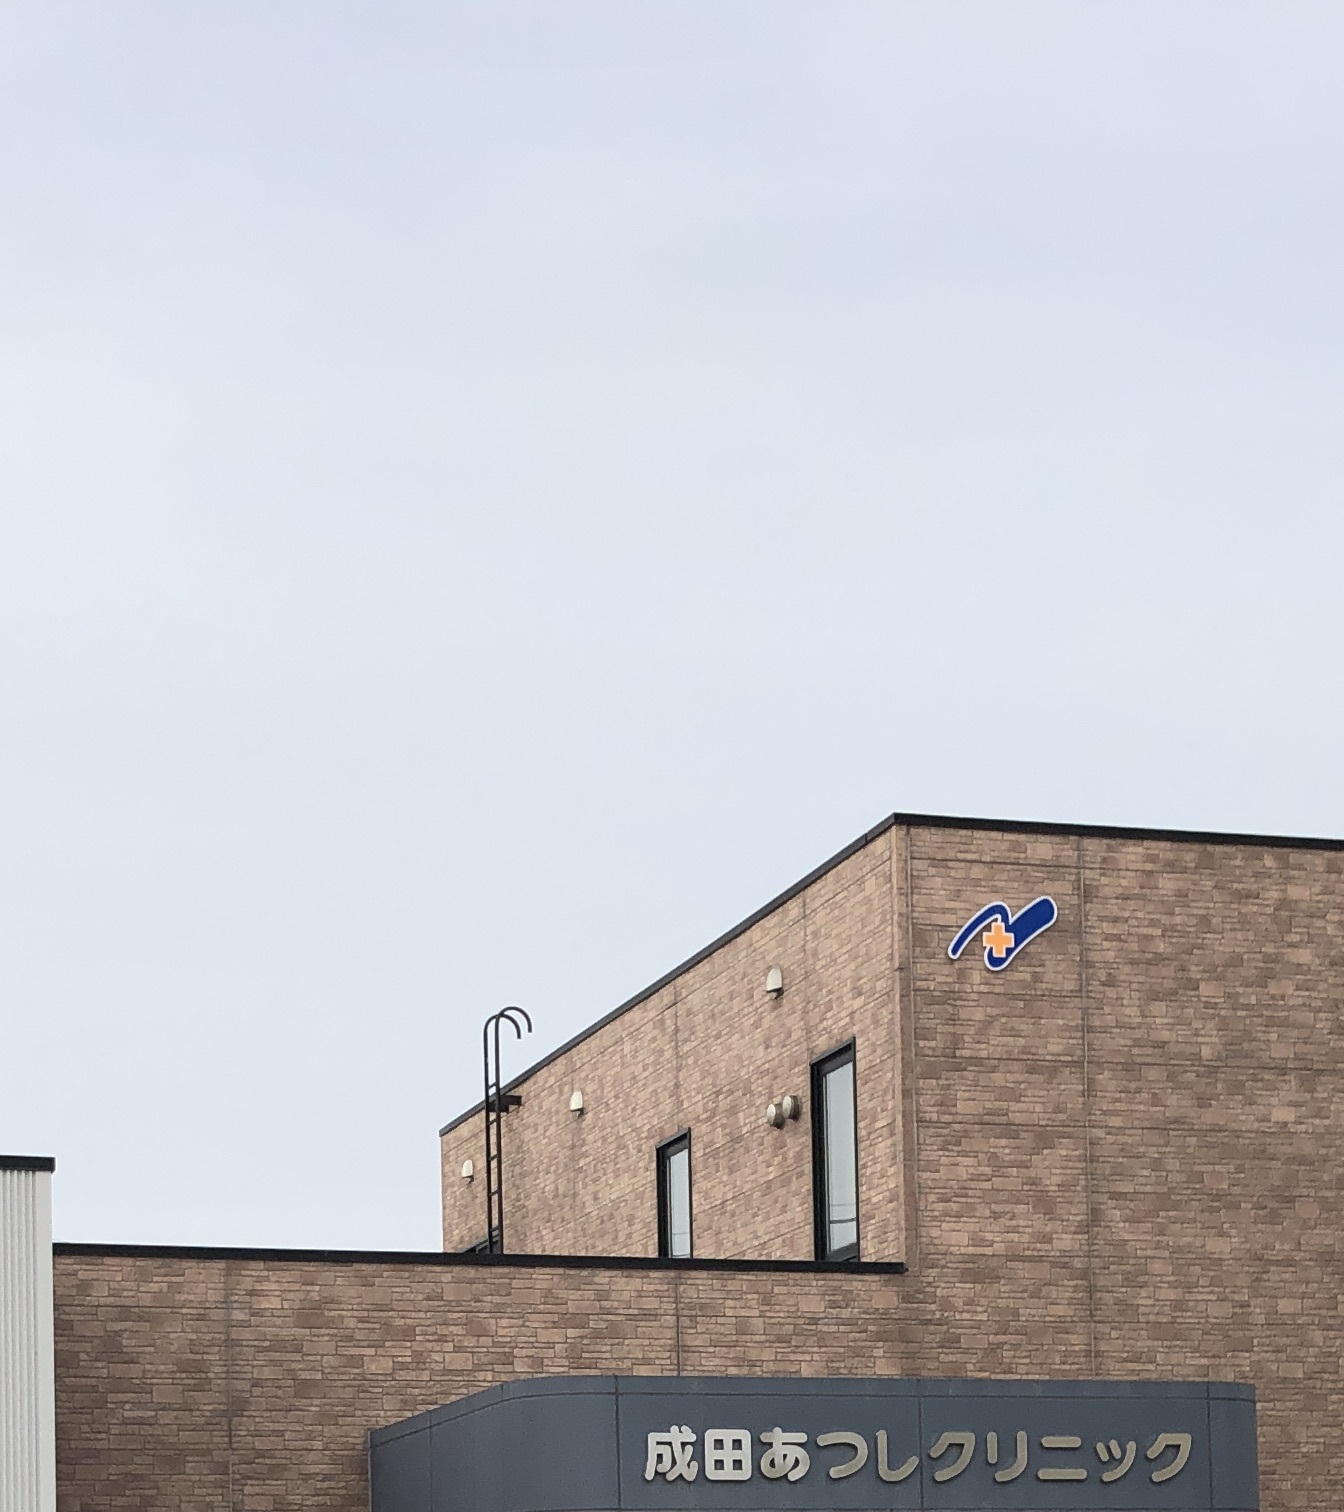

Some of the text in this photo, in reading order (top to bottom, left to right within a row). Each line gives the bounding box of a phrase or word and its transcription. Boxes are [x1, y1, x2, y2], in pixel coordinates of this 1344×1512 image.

[644, 1425, 1193, 1483] 成田あつしクリニック
